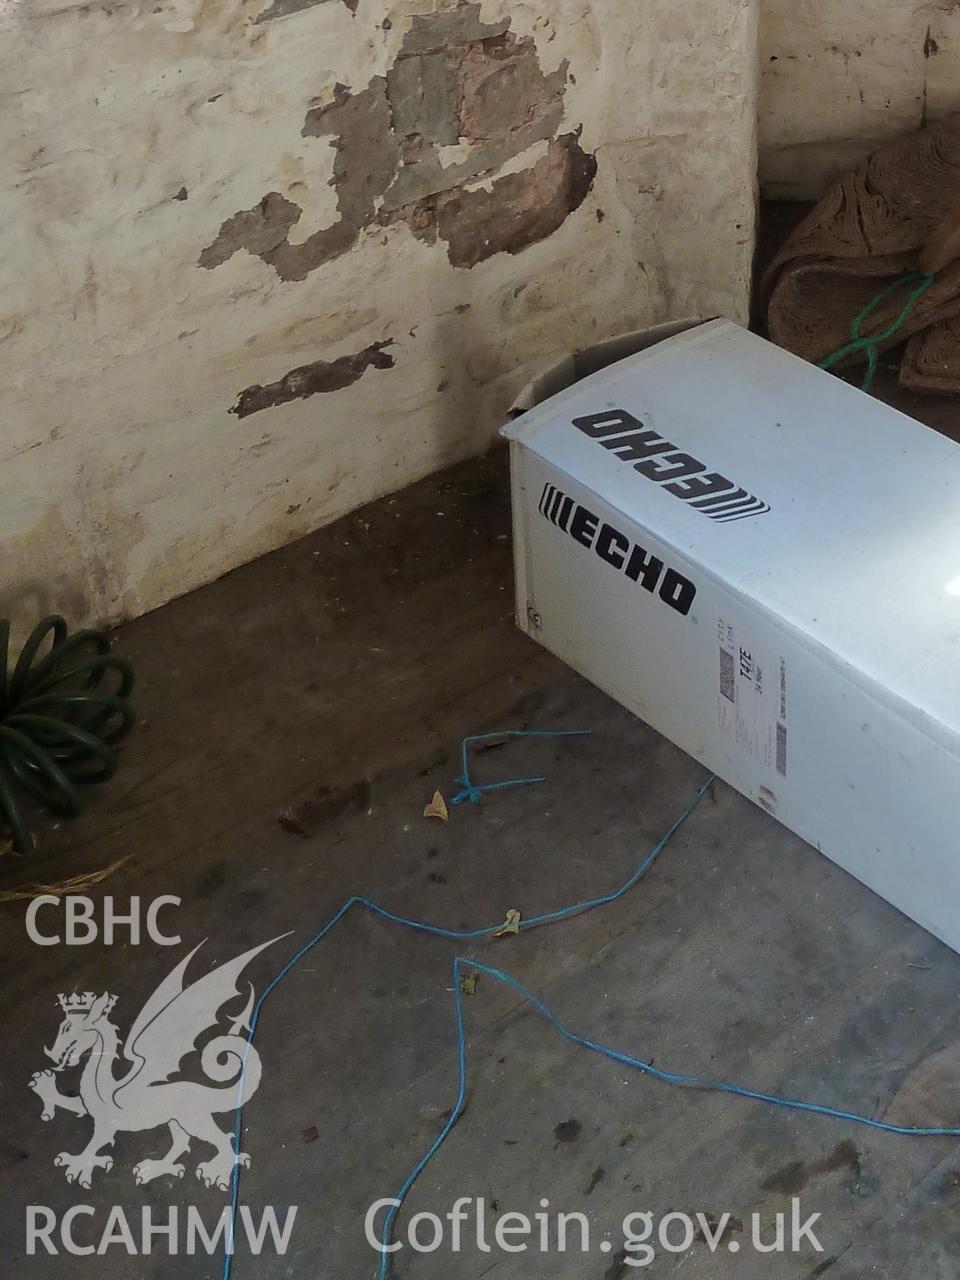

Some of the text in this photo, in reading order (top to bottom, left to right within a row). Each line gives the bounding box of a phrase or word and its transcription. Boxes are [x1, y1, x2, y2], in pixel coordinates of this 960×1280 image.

[570, 408, 735, 500] ECHO
[569, 504, 698, 616] ECHO
[739, 647, 752, 681] T47E
